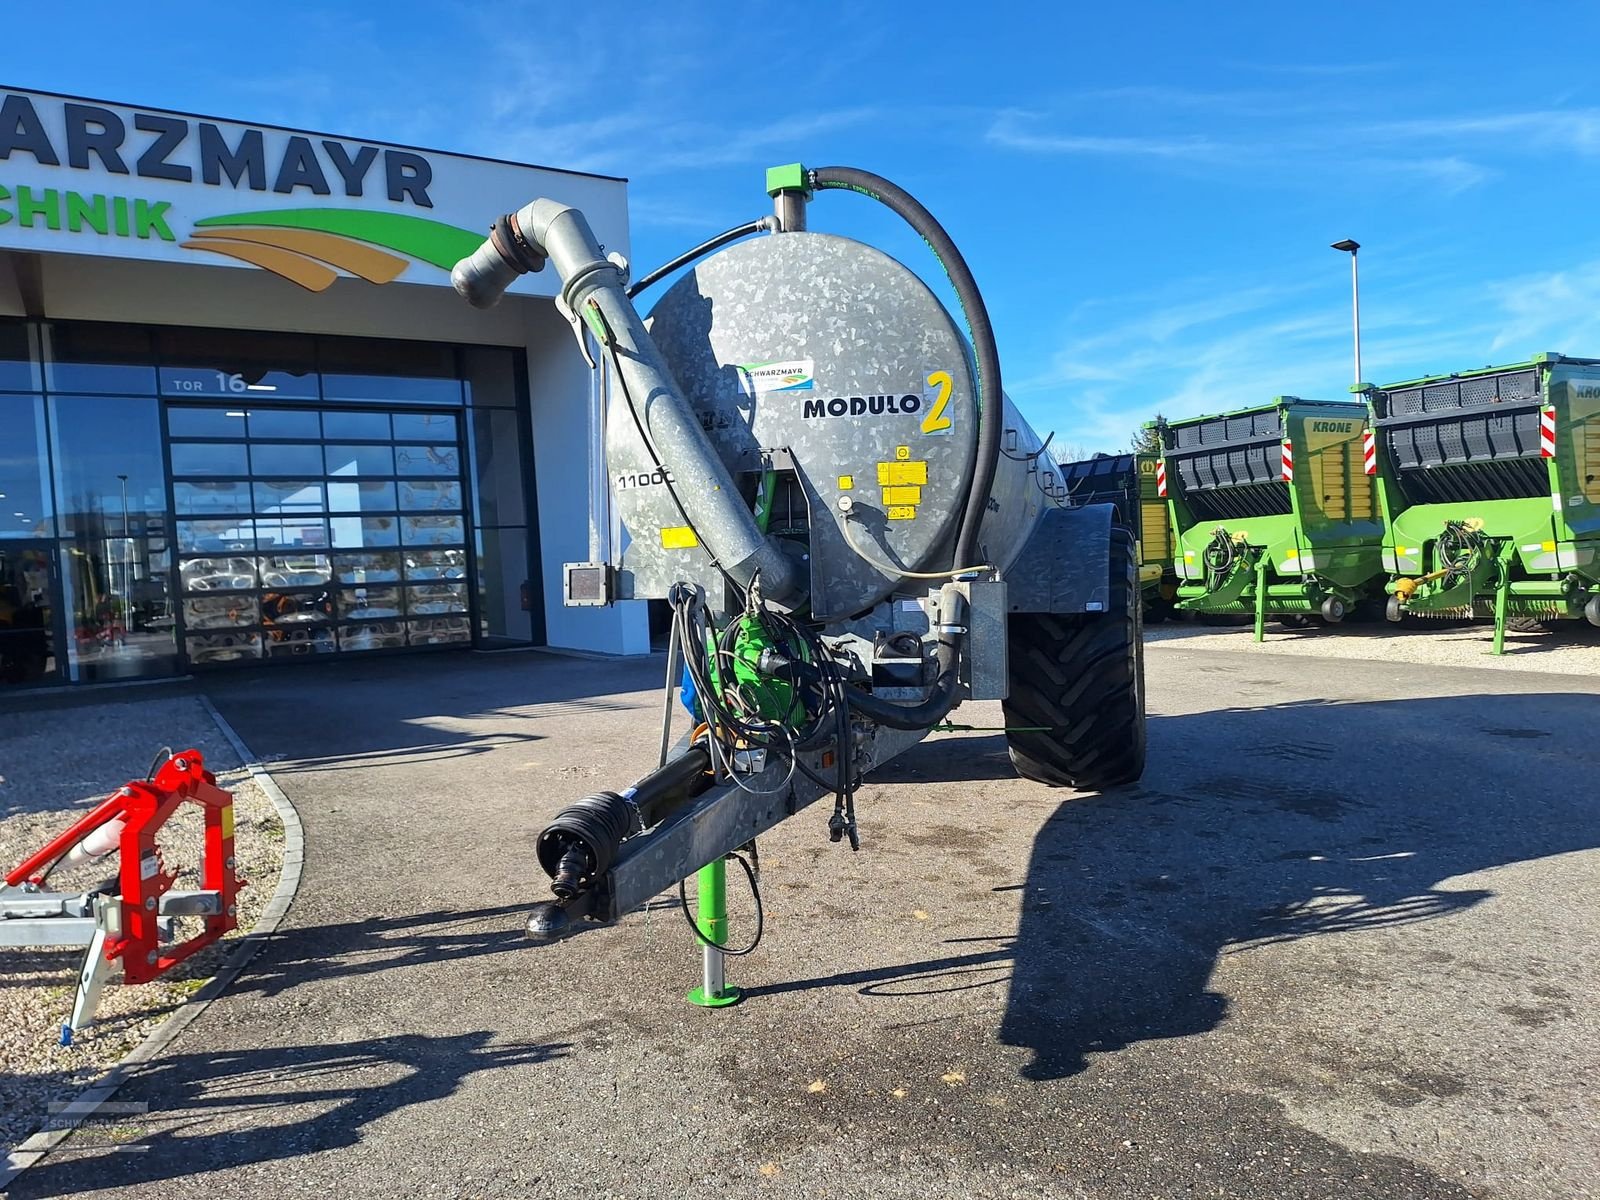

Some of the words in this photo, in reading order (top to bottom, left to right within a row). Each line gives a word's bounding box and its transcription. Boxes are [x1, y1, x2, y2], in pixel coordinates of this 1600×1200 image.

[0, 94, 434, 208] ARZMAYR
[173, 380, 203, 391] TOR
[216, 372, 247, 393] 16
[745, 368, 803, 378] SCHWARZMAYR
[803, 394, 921, 419] MODULO
[920, 370, 953, 435] 2
[1312, 421, 1353, 433] KRONE
